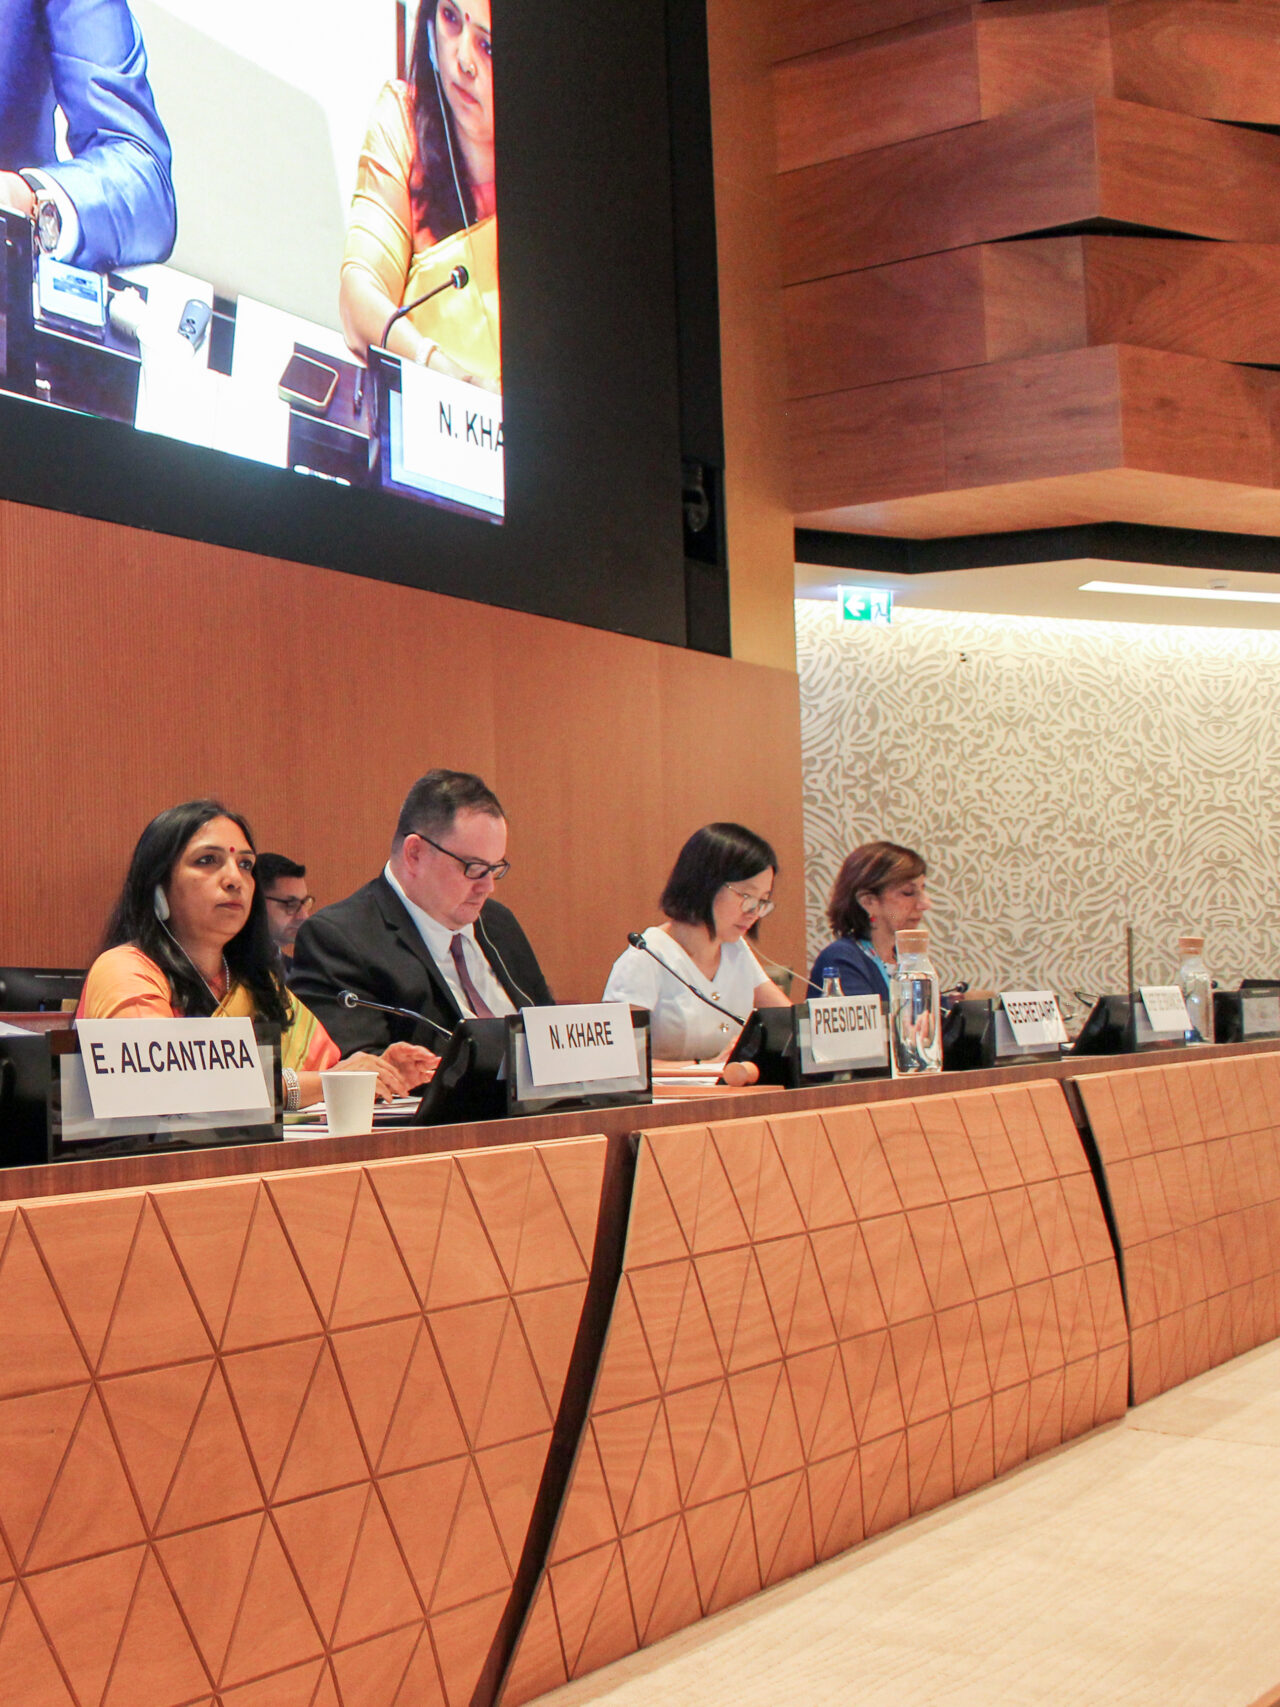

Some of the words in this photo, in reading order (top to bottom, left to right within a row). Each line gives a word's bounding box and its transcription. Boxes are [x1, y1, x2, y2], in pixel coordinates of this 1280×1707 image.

[439, 400, 458, 439] N.
[548, 1024, 564, 1050] N.
[566, 1021, 614, 1049] KHARE
[814, 1005, 878, 1035] PRESIDENT
[90, 1042, 115, 1075] E.
[121, 1039, 255, 1074] ALCANTARA
